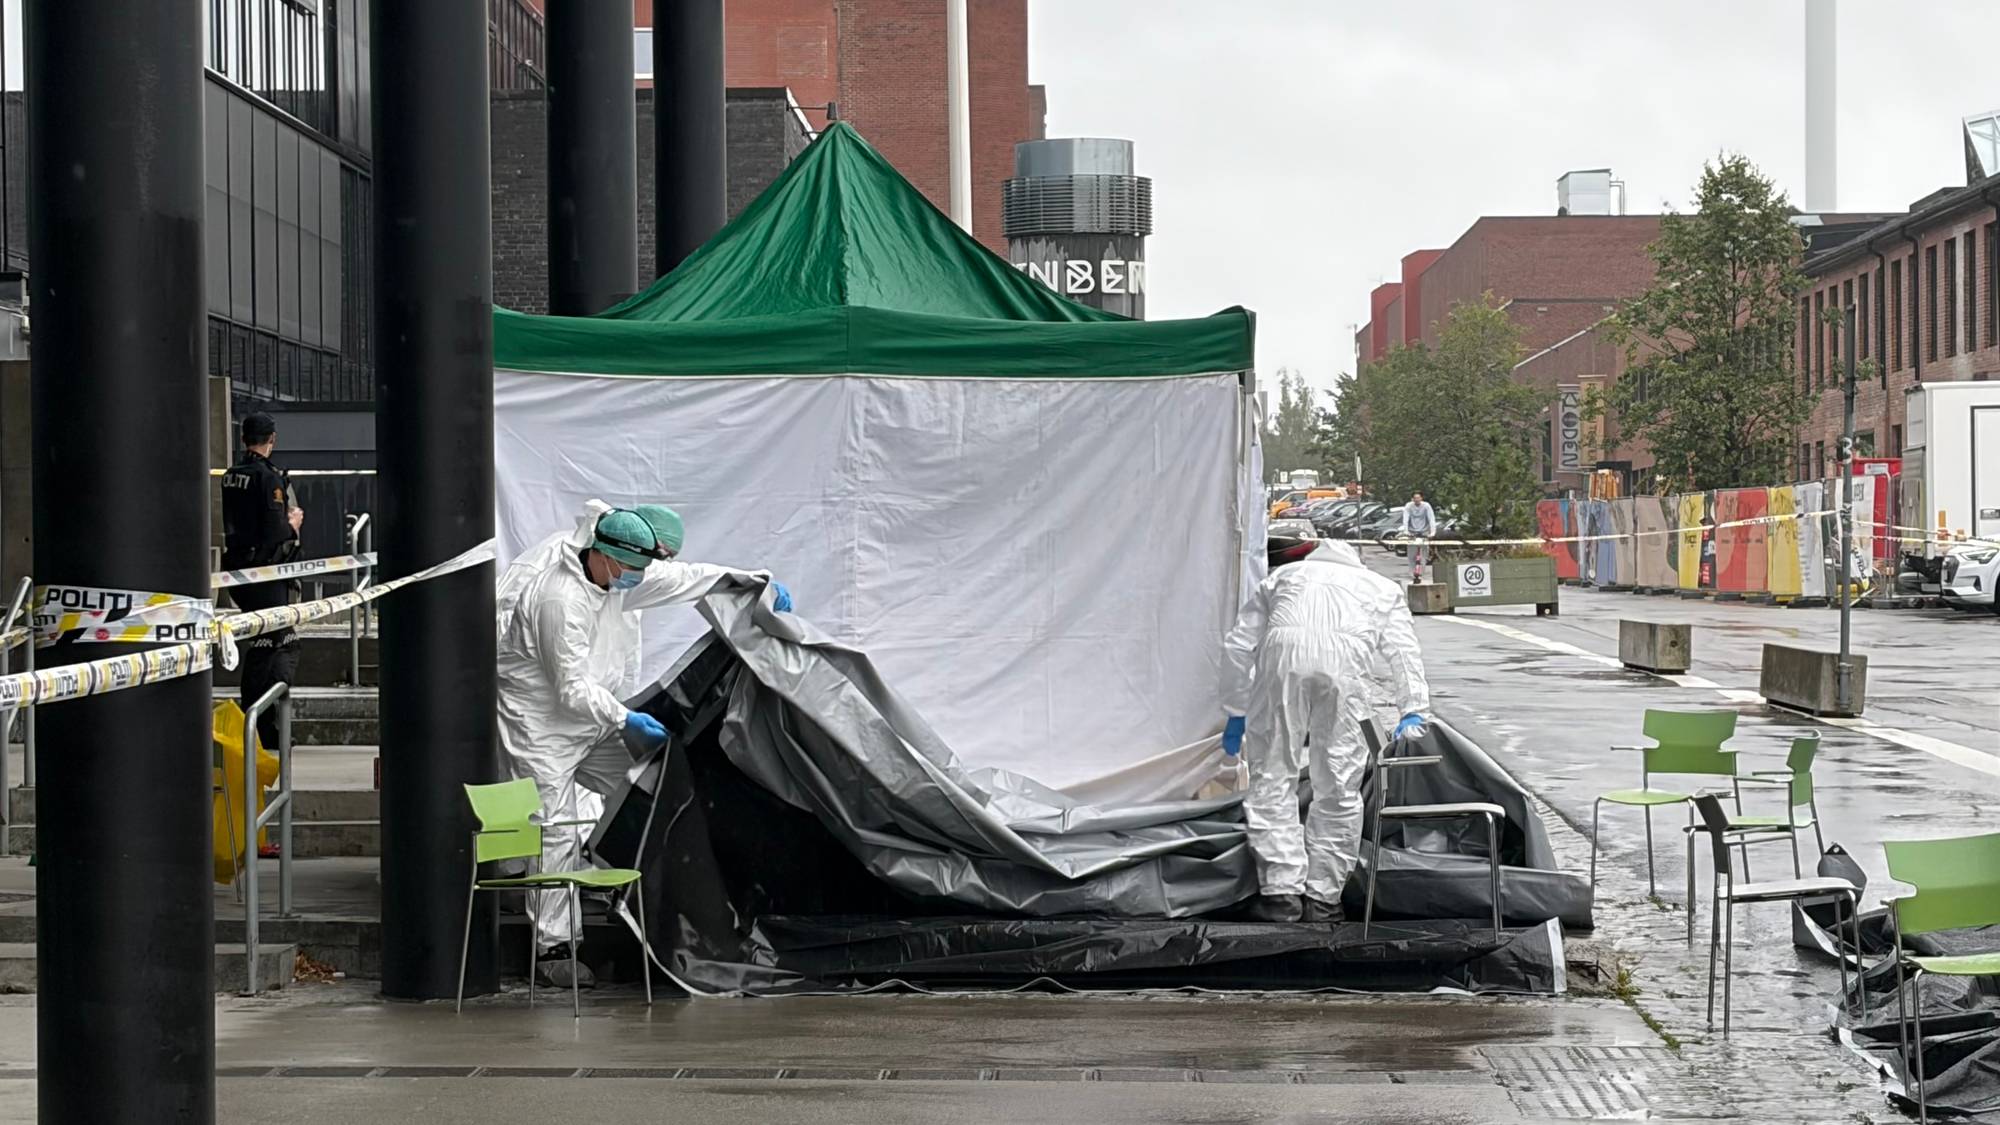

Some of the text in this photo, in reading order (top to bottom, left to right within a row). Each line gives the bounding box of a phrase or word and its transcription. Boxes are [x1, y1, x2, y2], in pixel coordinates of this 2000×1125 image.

[223, 473, 251, 490] OLITI
[1468, 570, 1481, 580] 20
[45, 587, 133, 611] POLITI
